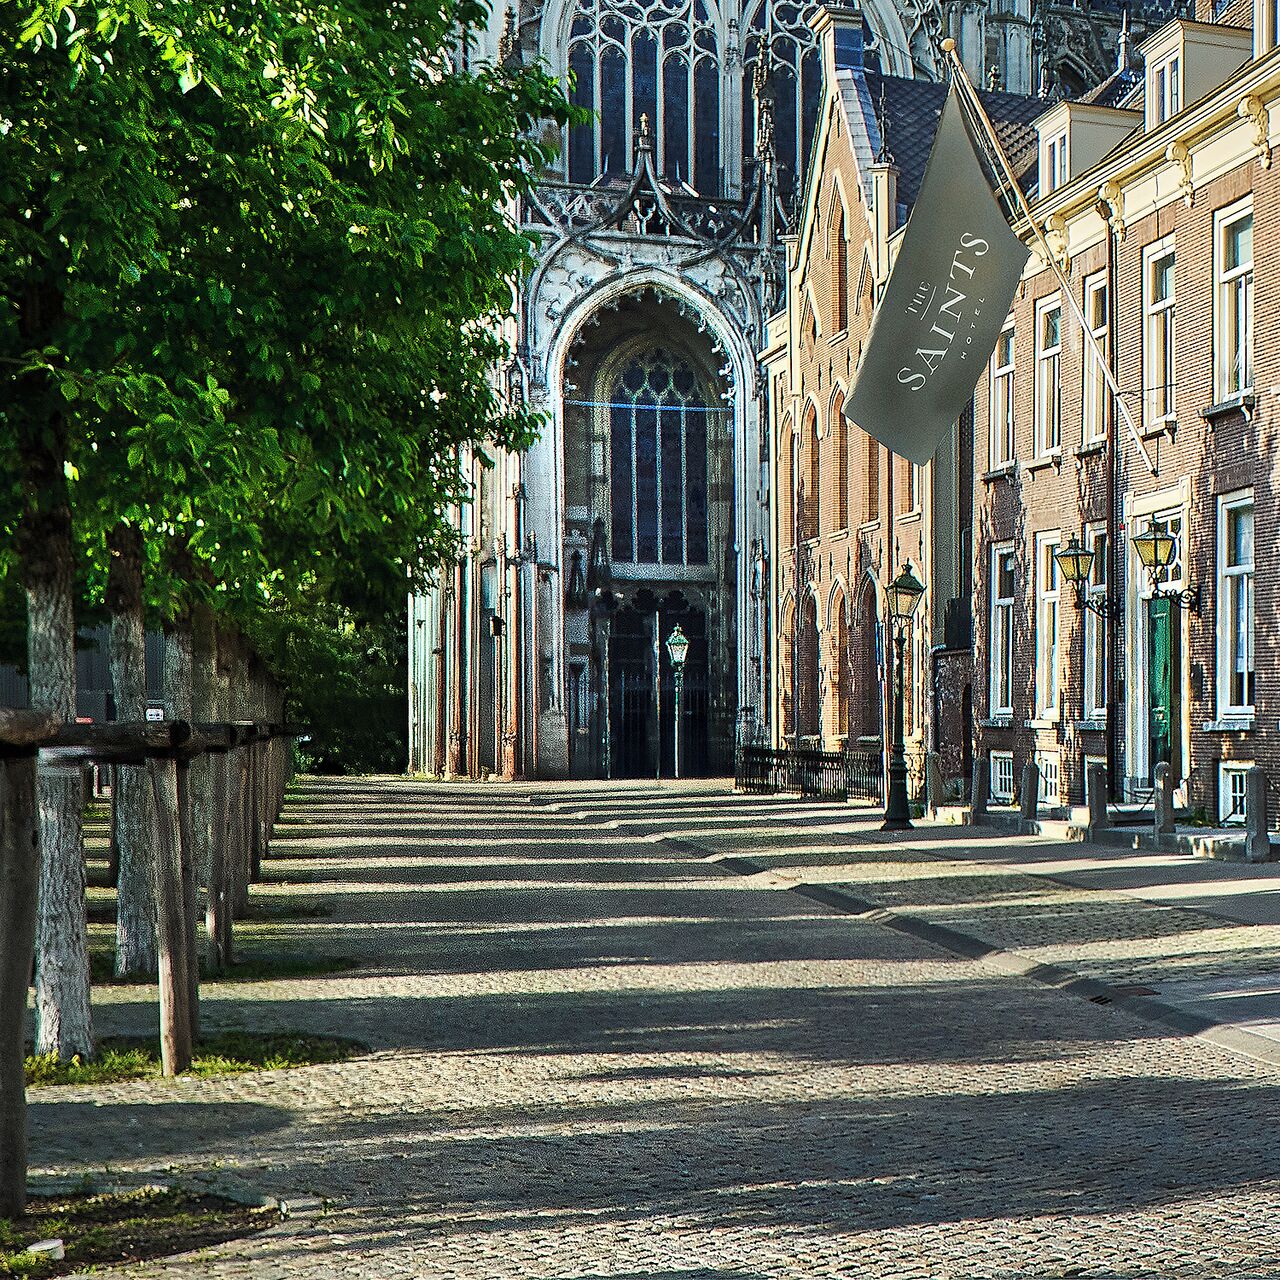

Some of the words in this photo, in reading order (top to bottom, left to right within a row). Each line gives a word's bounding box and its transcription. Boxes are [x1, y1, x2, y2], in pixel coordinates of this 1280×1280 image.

[897, 232, 989, 391] SAINTS
[905, 281, 931, 314] THE
[961, 297, 985, 360] HOTEL
